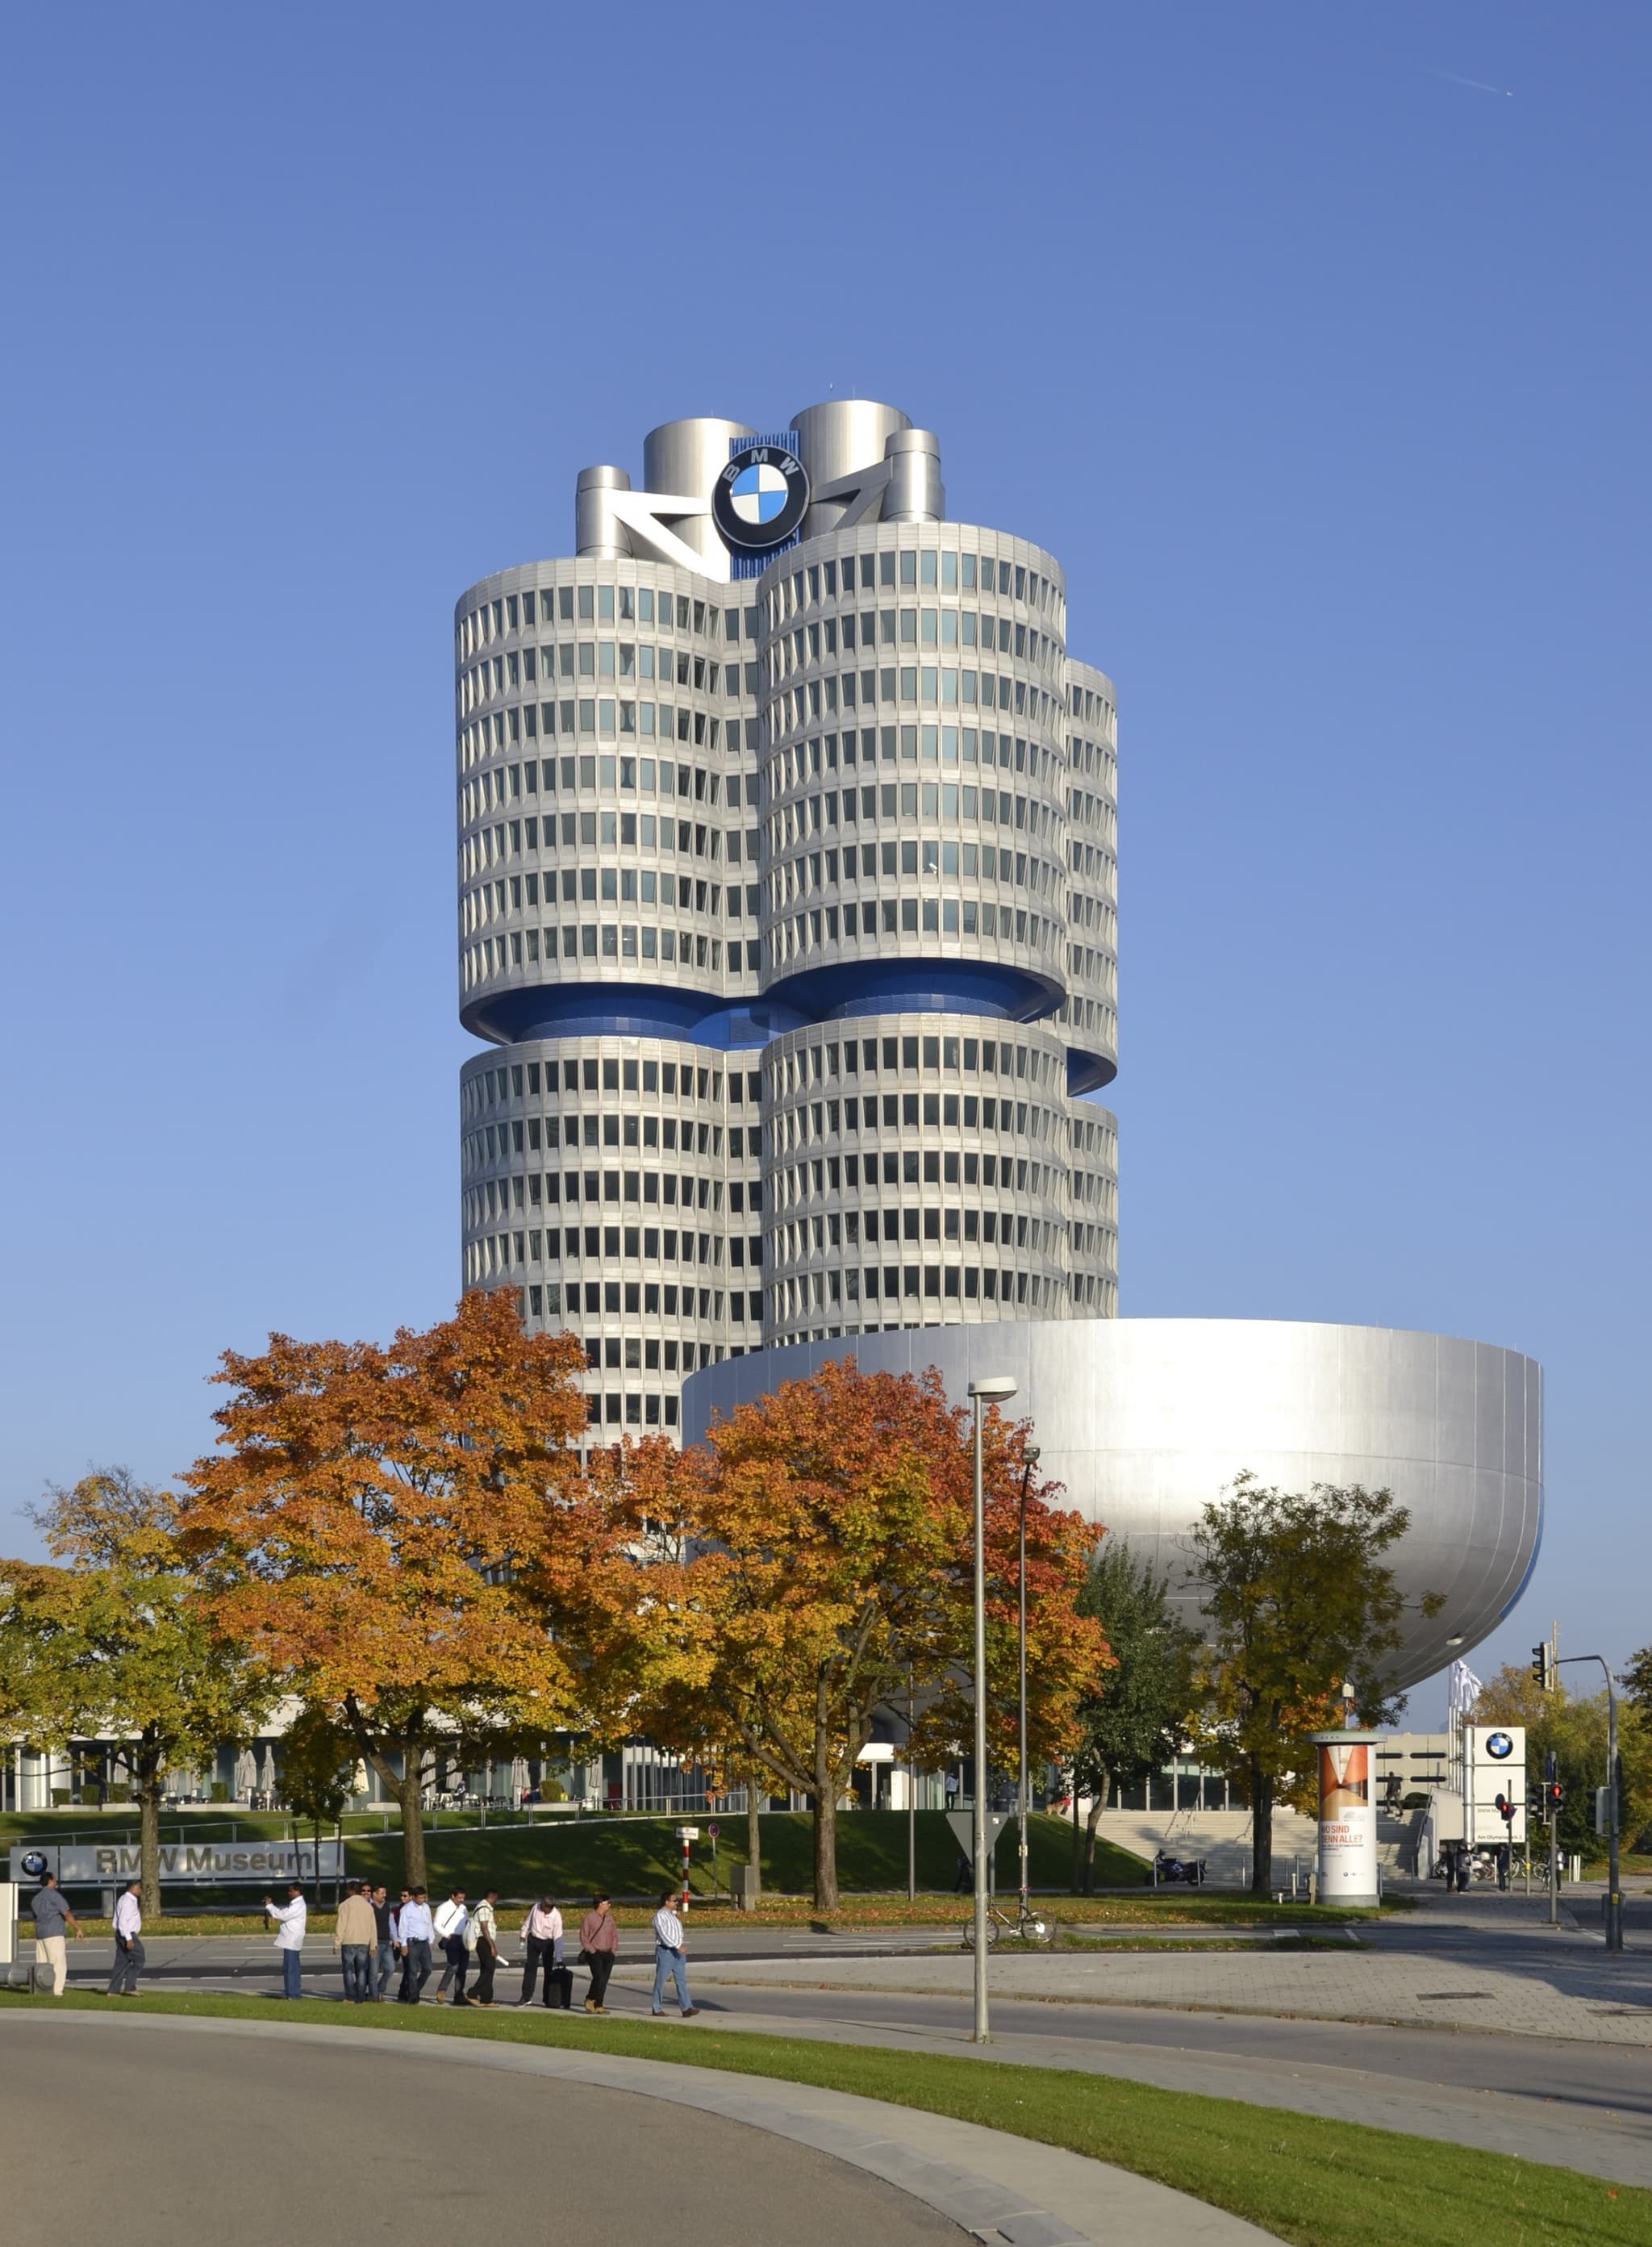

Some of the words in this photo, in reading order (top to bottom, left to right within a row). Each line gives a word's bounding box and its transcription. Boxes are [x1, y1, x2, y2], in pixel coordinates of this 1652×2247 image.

[723, 449, 799, 483] BMW
[1331, 1825, 1350, 1834] SIND
[1339, 1834, 1362, 1844] ALLE?
[186, 1847, 312, 1873] Museum
